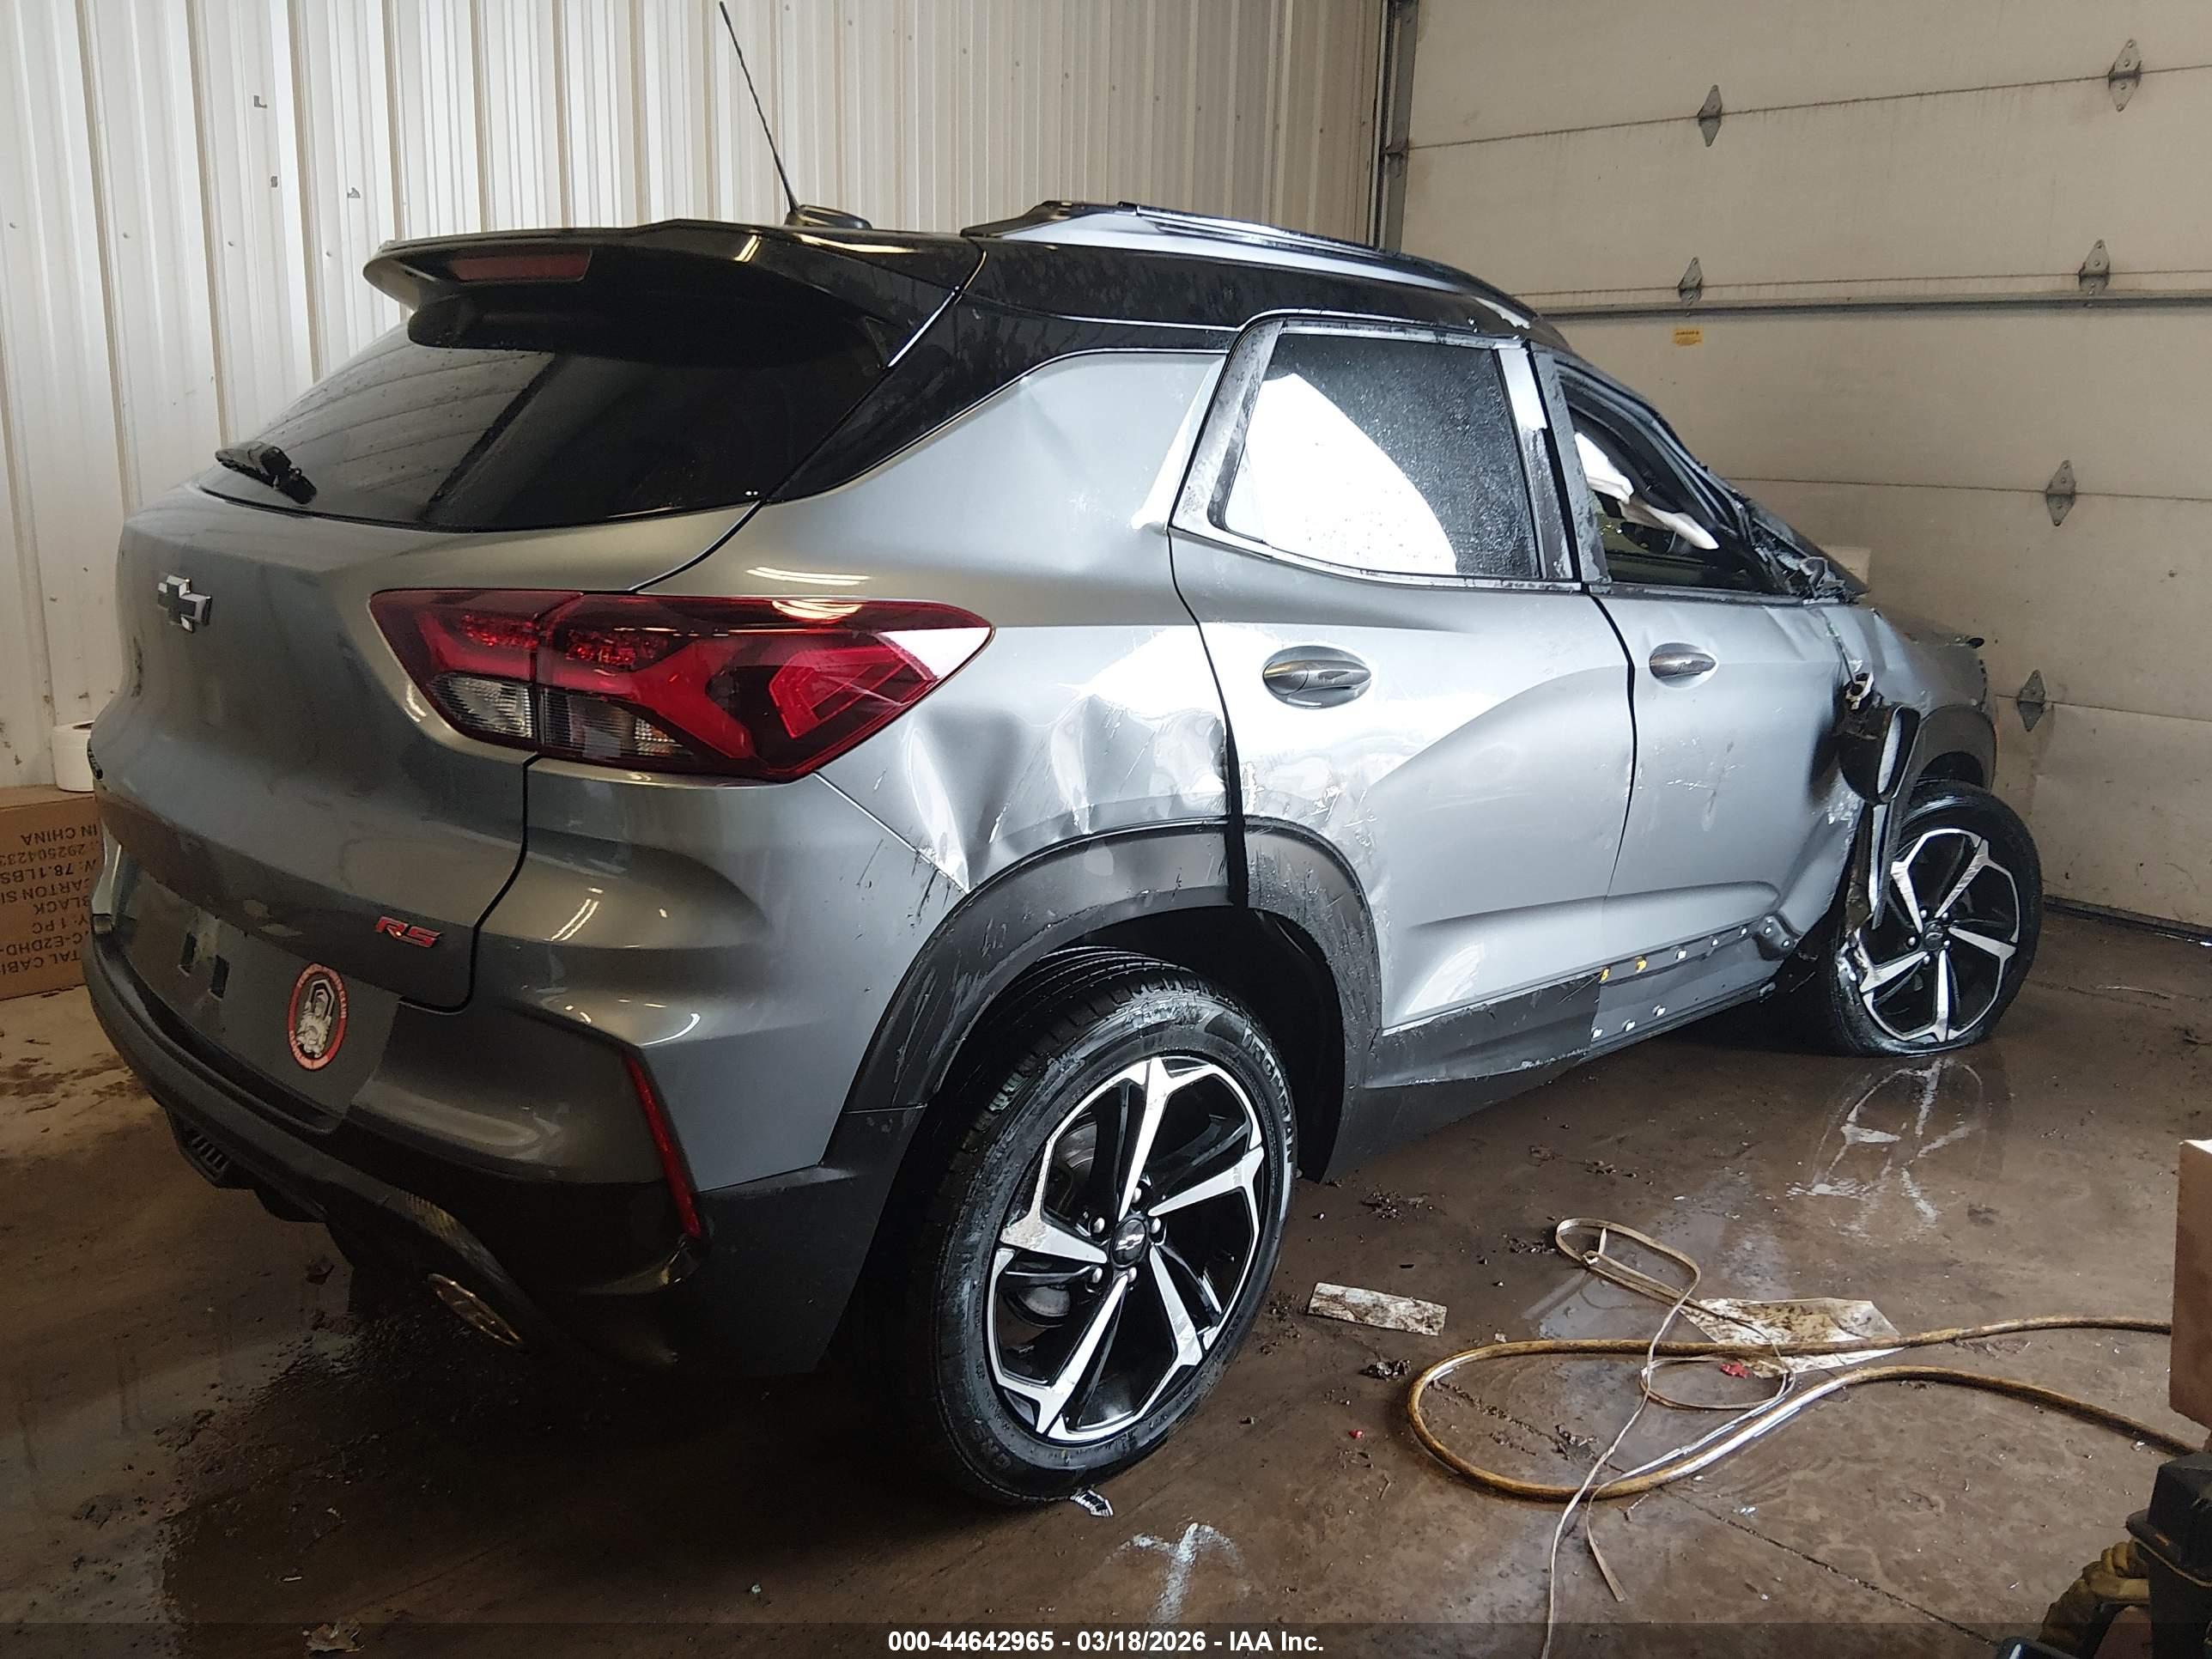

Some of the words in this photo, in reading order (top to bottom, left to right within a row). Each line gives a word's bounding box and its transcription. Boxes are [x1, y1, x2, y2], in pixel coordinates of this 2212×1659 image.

[21, 827, 76, 846] CHINA
[81, 824, 97, 837] IN
[32, 920, 56, 934] PC
[374, 915, 442, 949] RS
[49, 949, 82, 964] TAL
[0, 957, 45, 975] CABI
